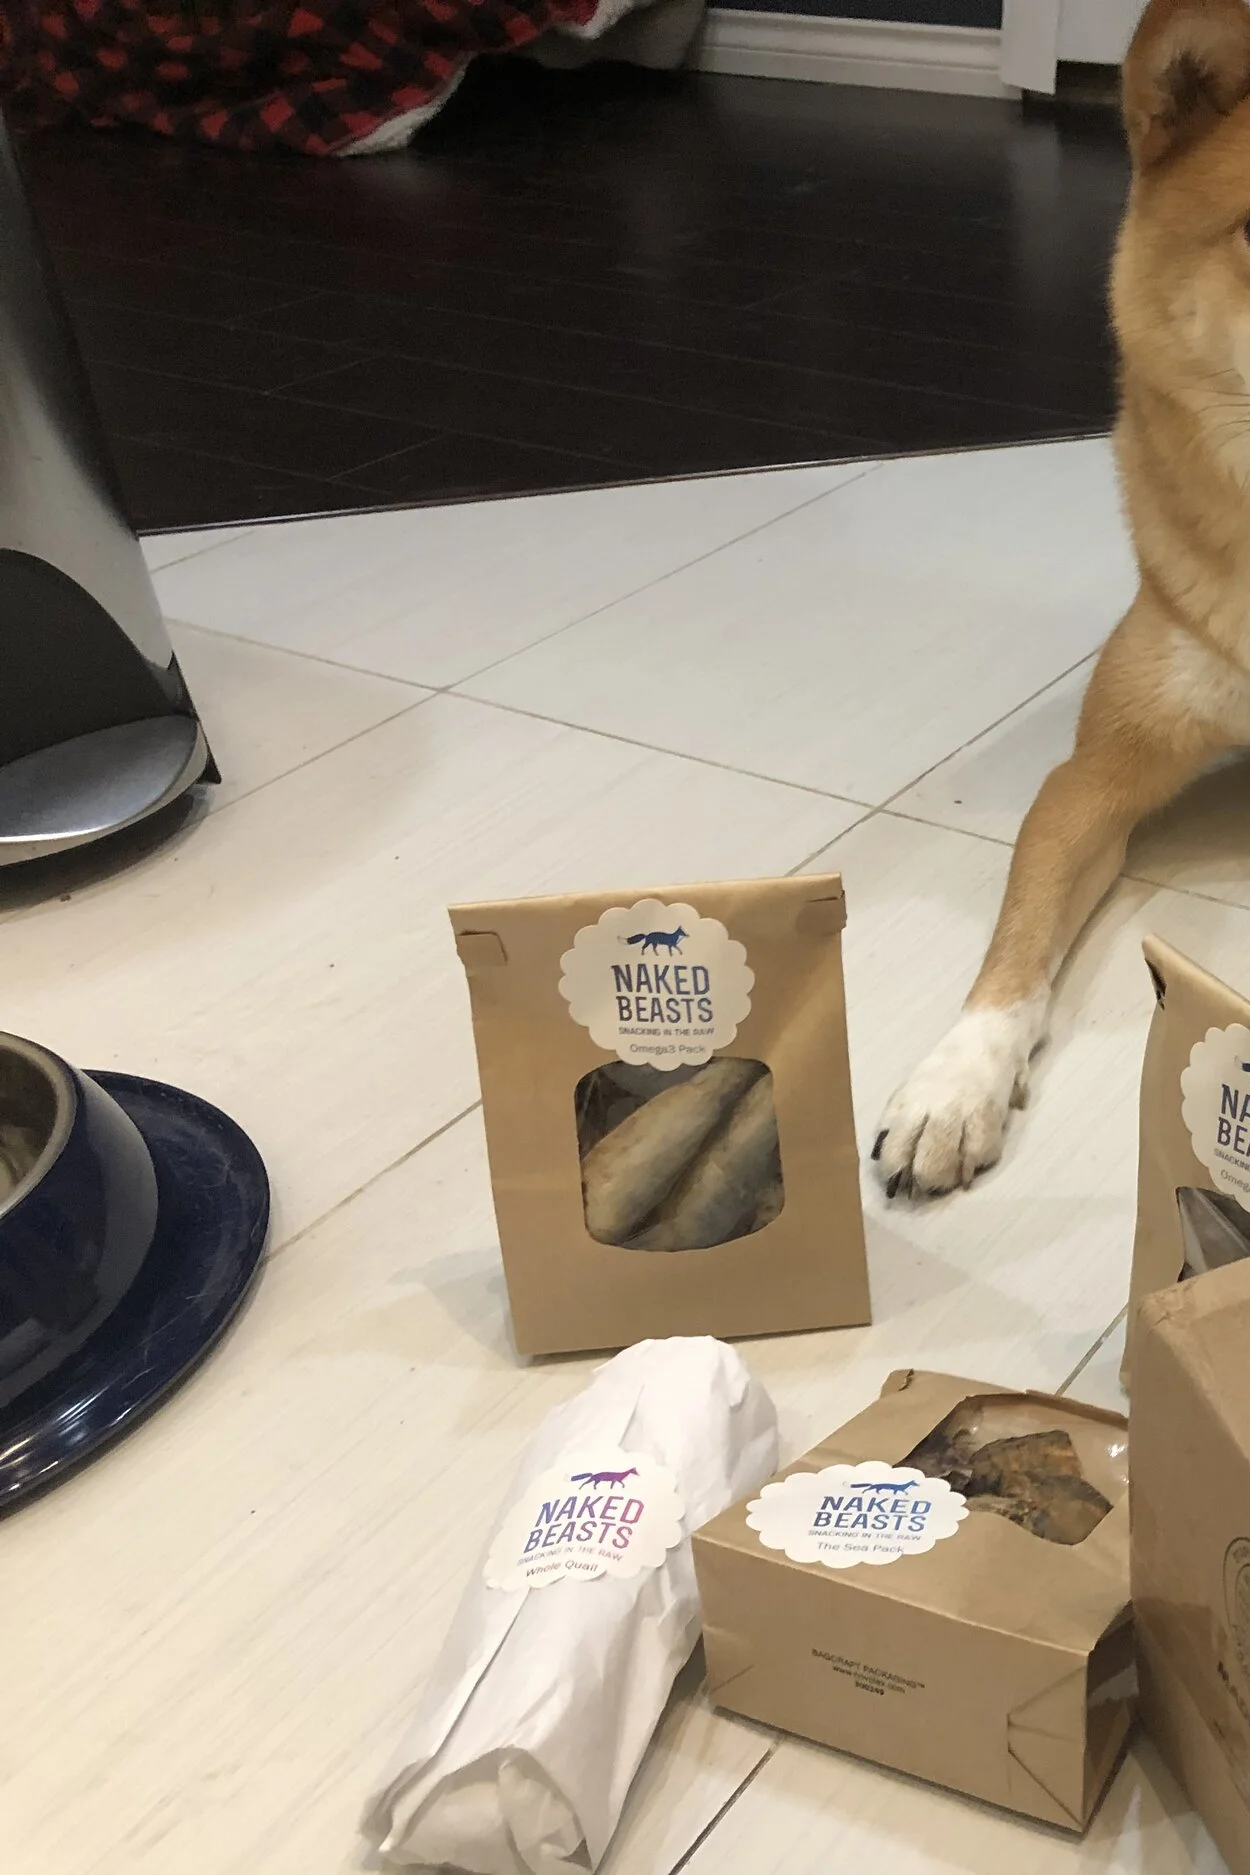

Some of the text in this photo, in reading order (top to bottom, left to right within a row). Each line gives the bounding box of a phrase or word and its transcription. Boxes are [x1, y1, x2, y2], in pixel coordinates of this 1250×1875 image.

[611, 963, 710, 995] NAKED
[616, 996, 713, 1023] BEASTS
[618, 1027, 715, 1036] SNACKING IN THE RAW
[630, 1044, 706, 1055] Omega3 Pack
[535, 1496, 644, 1527] NAKED
[821, 1496, 932, 1514] NAKED
[813, 1511, 926, 1532] BEASTS
[523, 1521, 633, 1554] BEASTS
[808, 1530, 859, 1538] SNACKING
[517, 1548, 562, 1566] SNACKING
[579, 1546, 596, 1554] THE
[598, 1548, 623, 1561] RAW
[817, 1542, 905, 1553] The Sea Pack
[526, 1560, 598, 1577] Whole Quail
